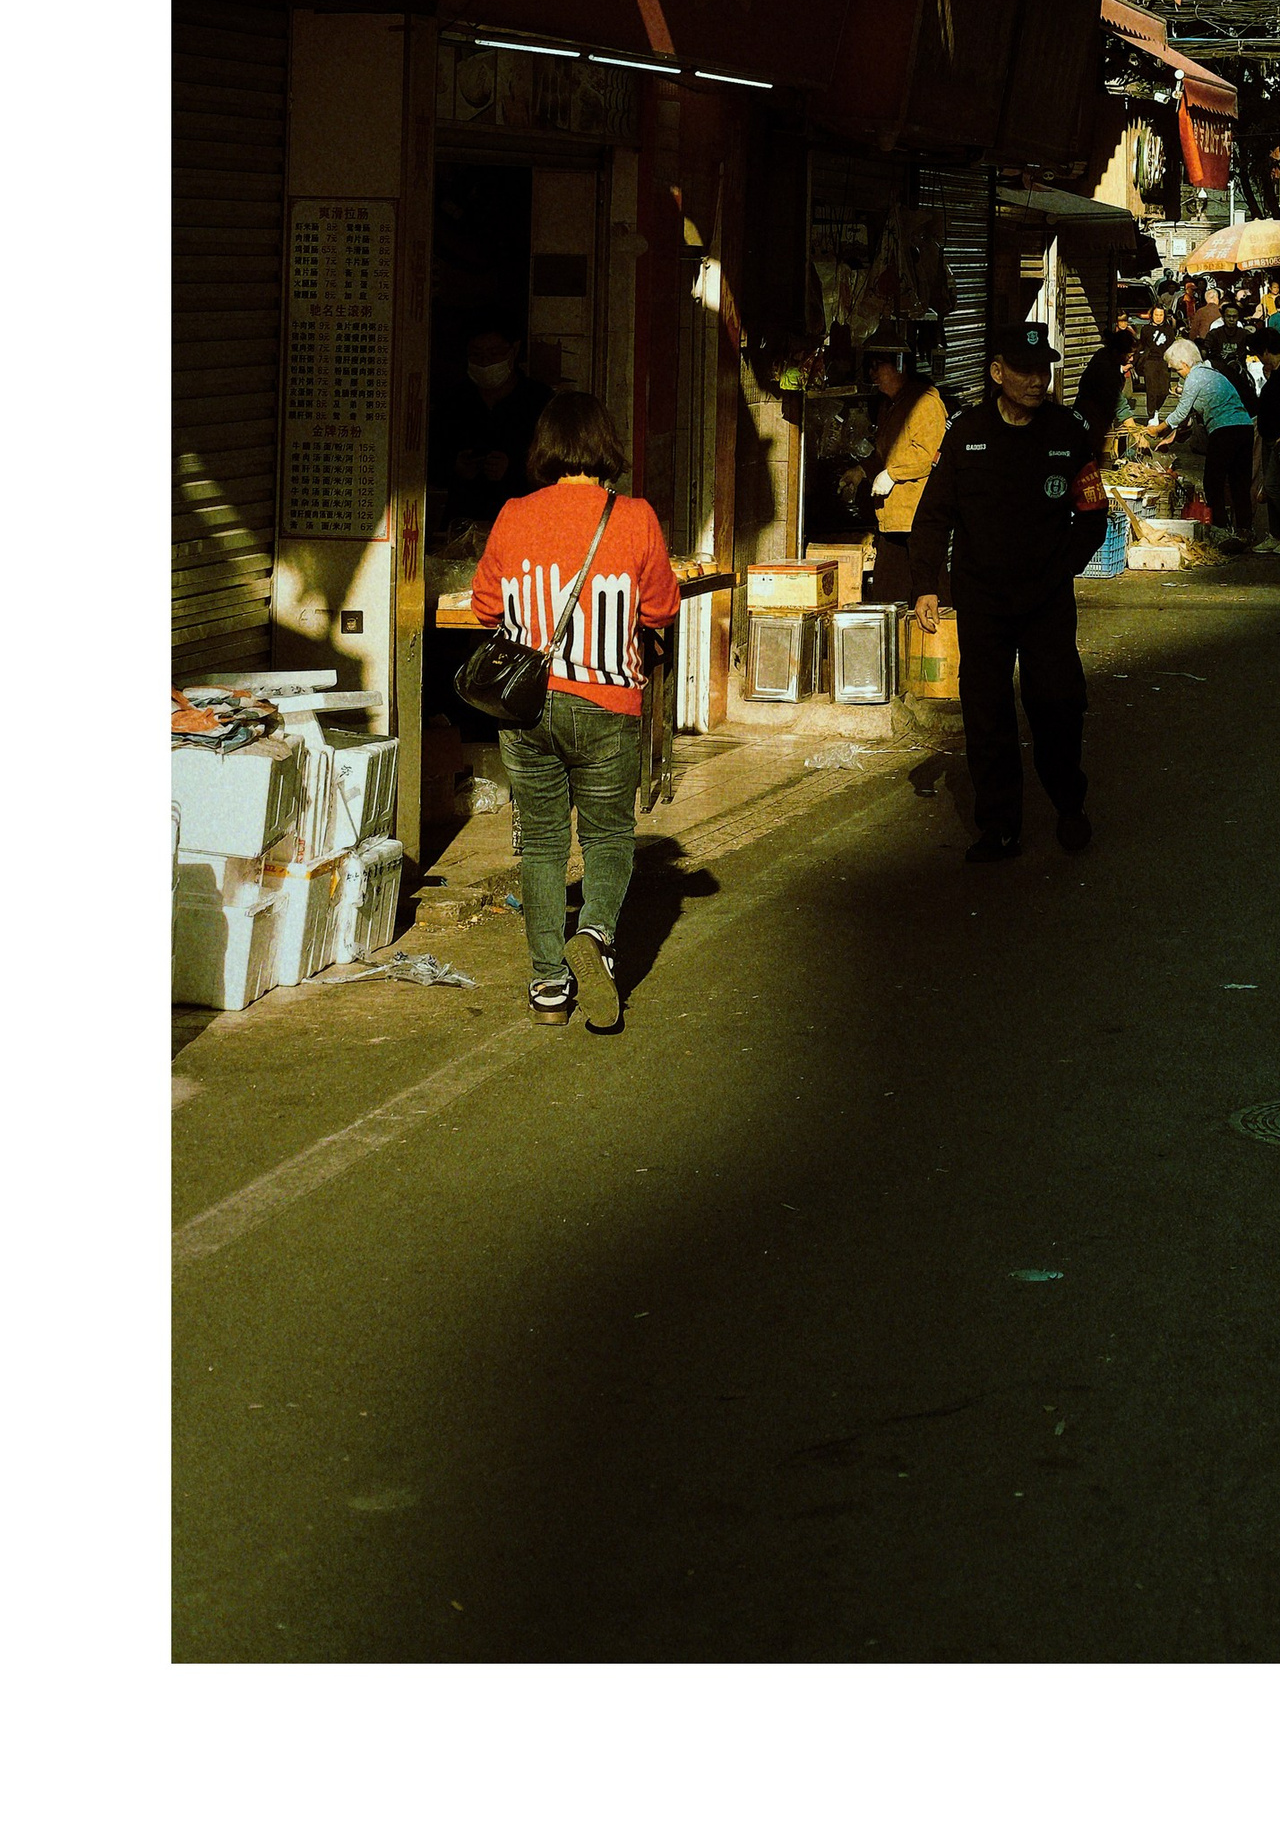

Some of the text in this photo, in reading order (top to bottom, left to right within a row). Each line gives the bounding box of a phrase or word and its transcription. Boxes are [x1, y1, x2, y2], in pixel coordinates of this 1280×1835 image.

[319, 207, 369, 220] 爽滑拉肠
[326, 223, 338, 231] 8元
[326, 234, 337, 243] 7元
[326, 257, 337, 265] 7元
[325, 269, 336, 277] 7元
[325, 280, 336, 288] 7元
[310, 304, 372, 317] 驰名生滚粥
[292, 321, 315, 330] 牛肉粥
[319, 333, 330, 341] 9元
[313, 425, 362, 438] 金牌汤粉
[359, 444, 376, 452] 15元
[359, 455, 376, 463] 10元
[359, 466, 375, 474] 10元
[359, 477, 374, 485] 10元
[358, 488, 374, 496] 12元
[358, 500, 374, 508] 12元
[358, 512, 373, 520] 12元
[360, 523, 373, 531] 6元
